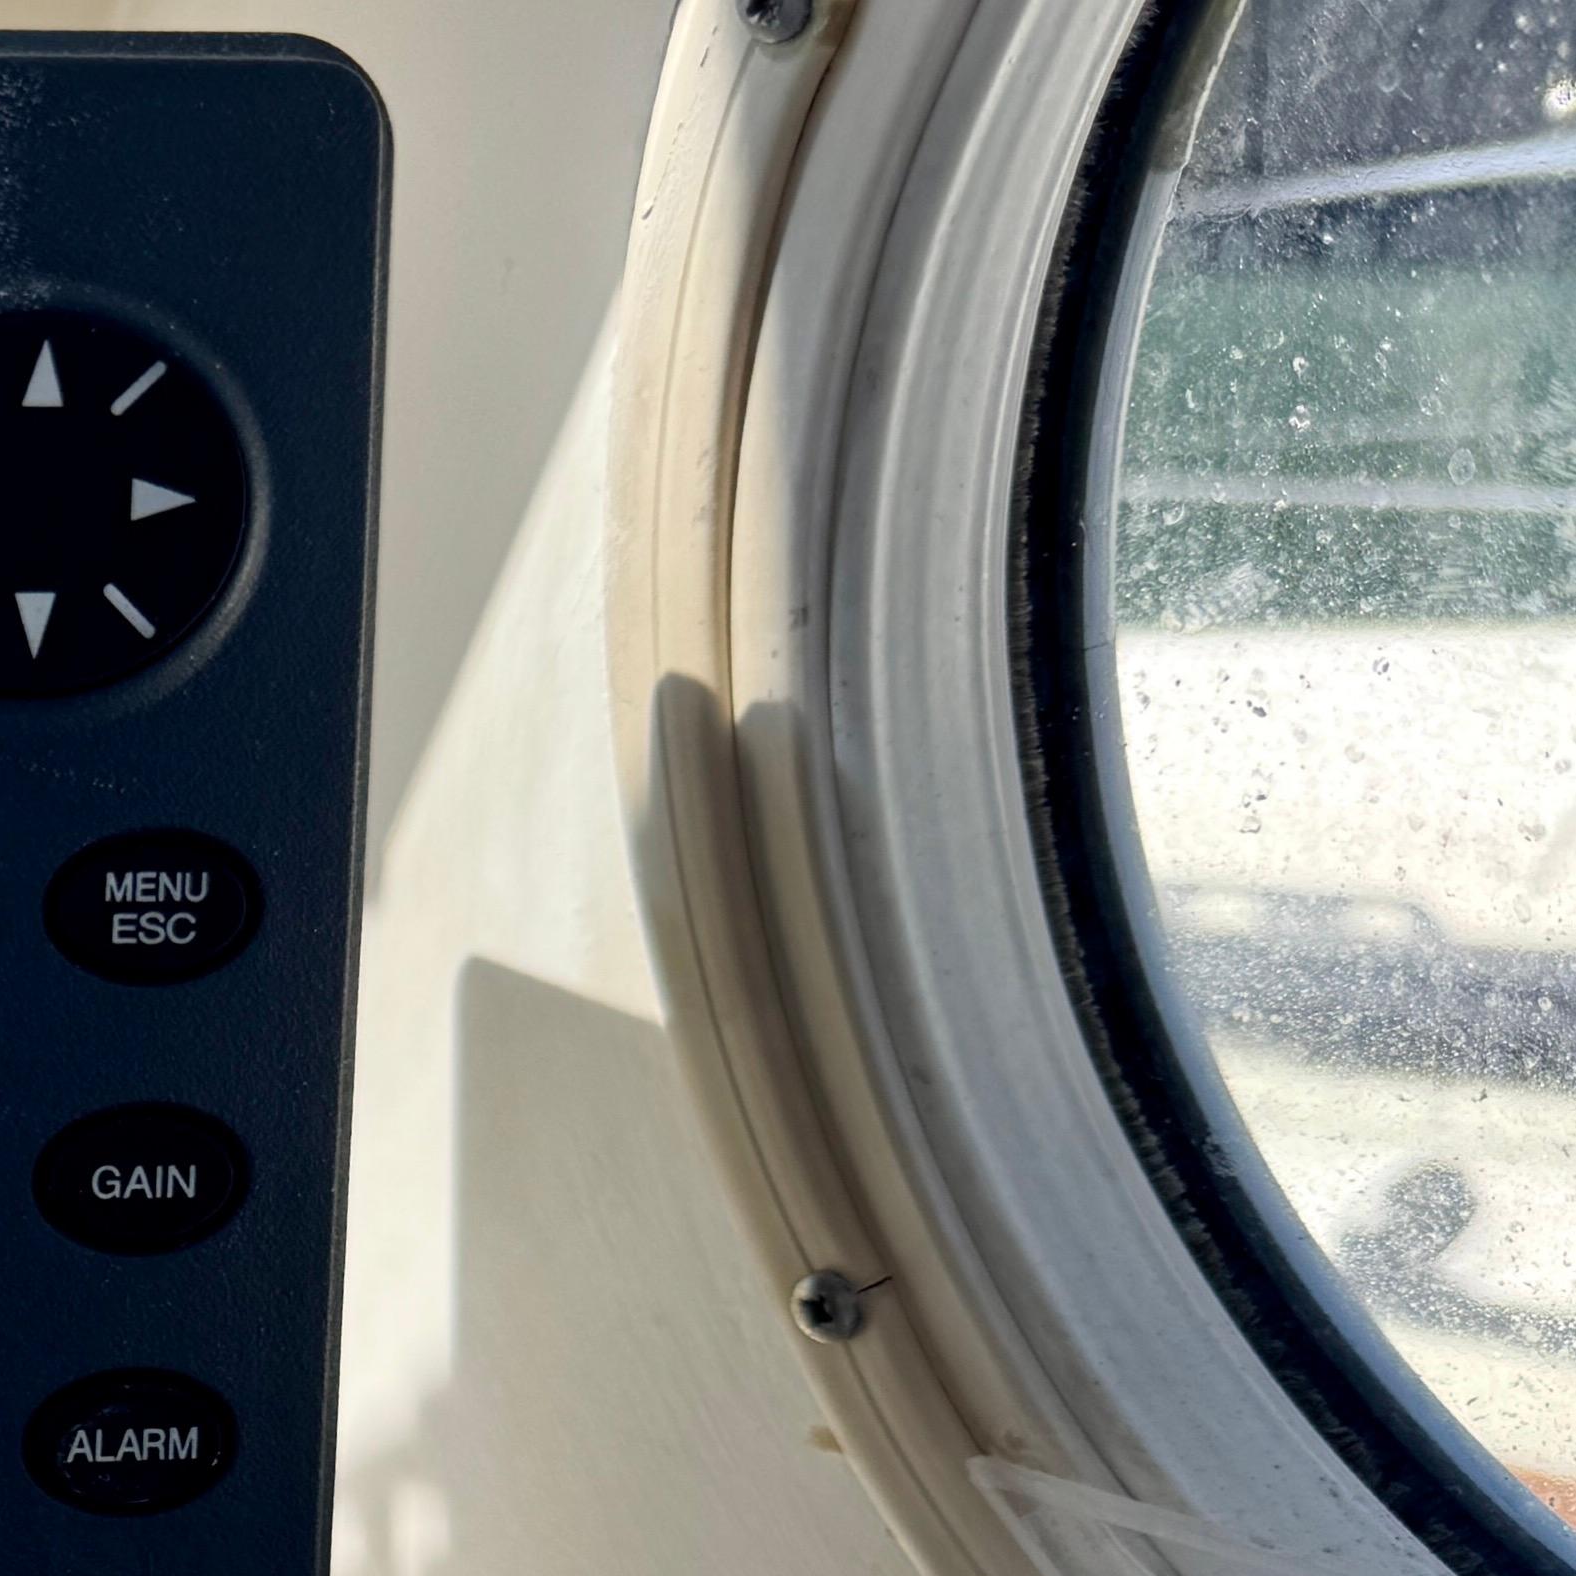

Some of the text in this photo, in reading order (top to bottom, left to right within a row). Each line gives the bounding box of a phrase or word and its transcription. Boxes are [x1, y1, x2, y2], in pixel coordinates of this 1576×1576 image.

[104, 871, 210, 904] MENU
[111, 911, 197, 945] ESC
[90, 1164, 198, 1200] GAIN
[66, 1427, 199, 1463] ALARM
